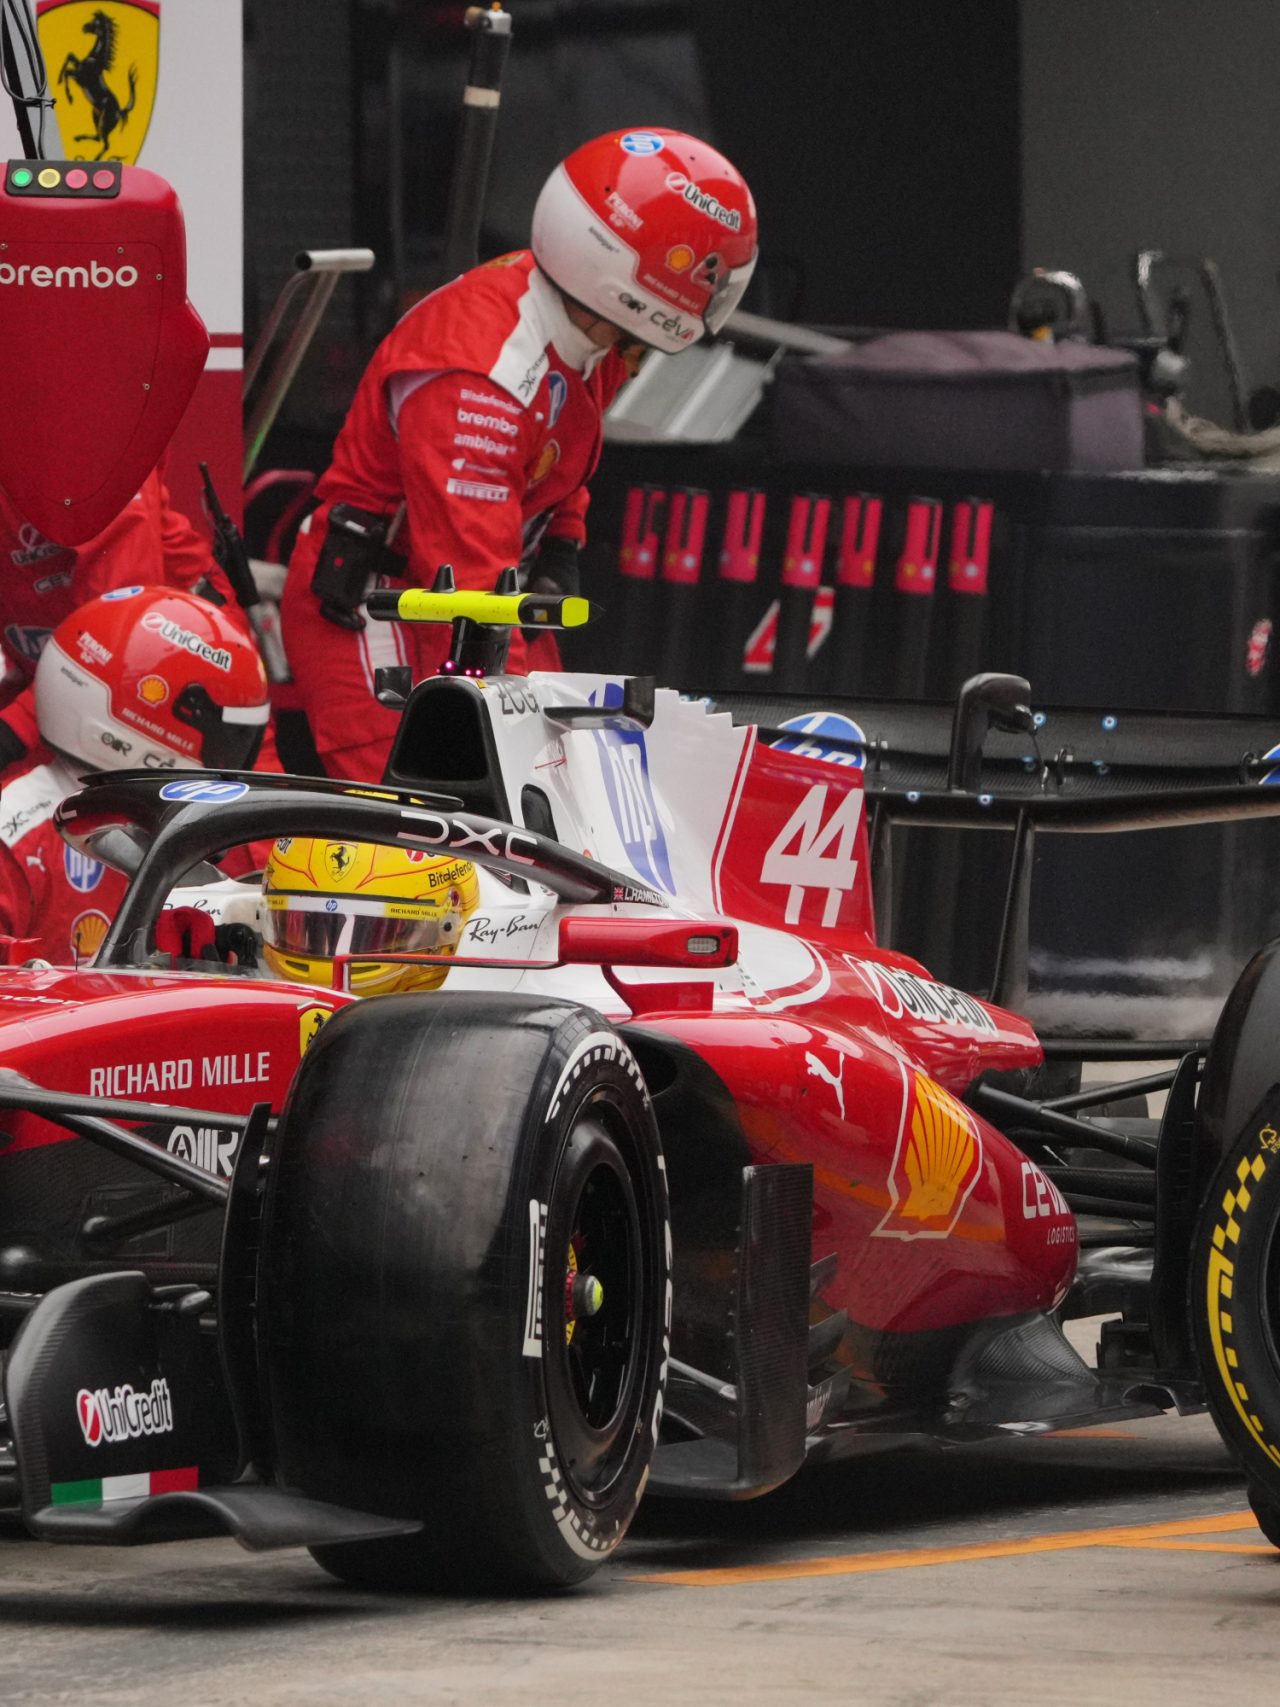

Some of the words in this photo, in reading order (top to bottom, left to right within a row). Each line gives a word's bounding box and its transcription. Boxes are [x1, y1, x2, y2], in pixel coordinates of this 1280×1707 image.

[684, 184, 742, 232] UniCredit
[457, 407, 518, 437] brembo
[160, 622, 232, 672] UniCredit
[397, 809, 538, 865] DXC
[760, 784, 865, 928] 44
[325, 899, 338, 912] hp
[467, 914, 540, 944] Ray-Ban
[90, 1058, 193, 1097] RICHARD
[201, 1051, 271, 1088] MILLE
[95, 1378, 173, 1442] UniCredit
